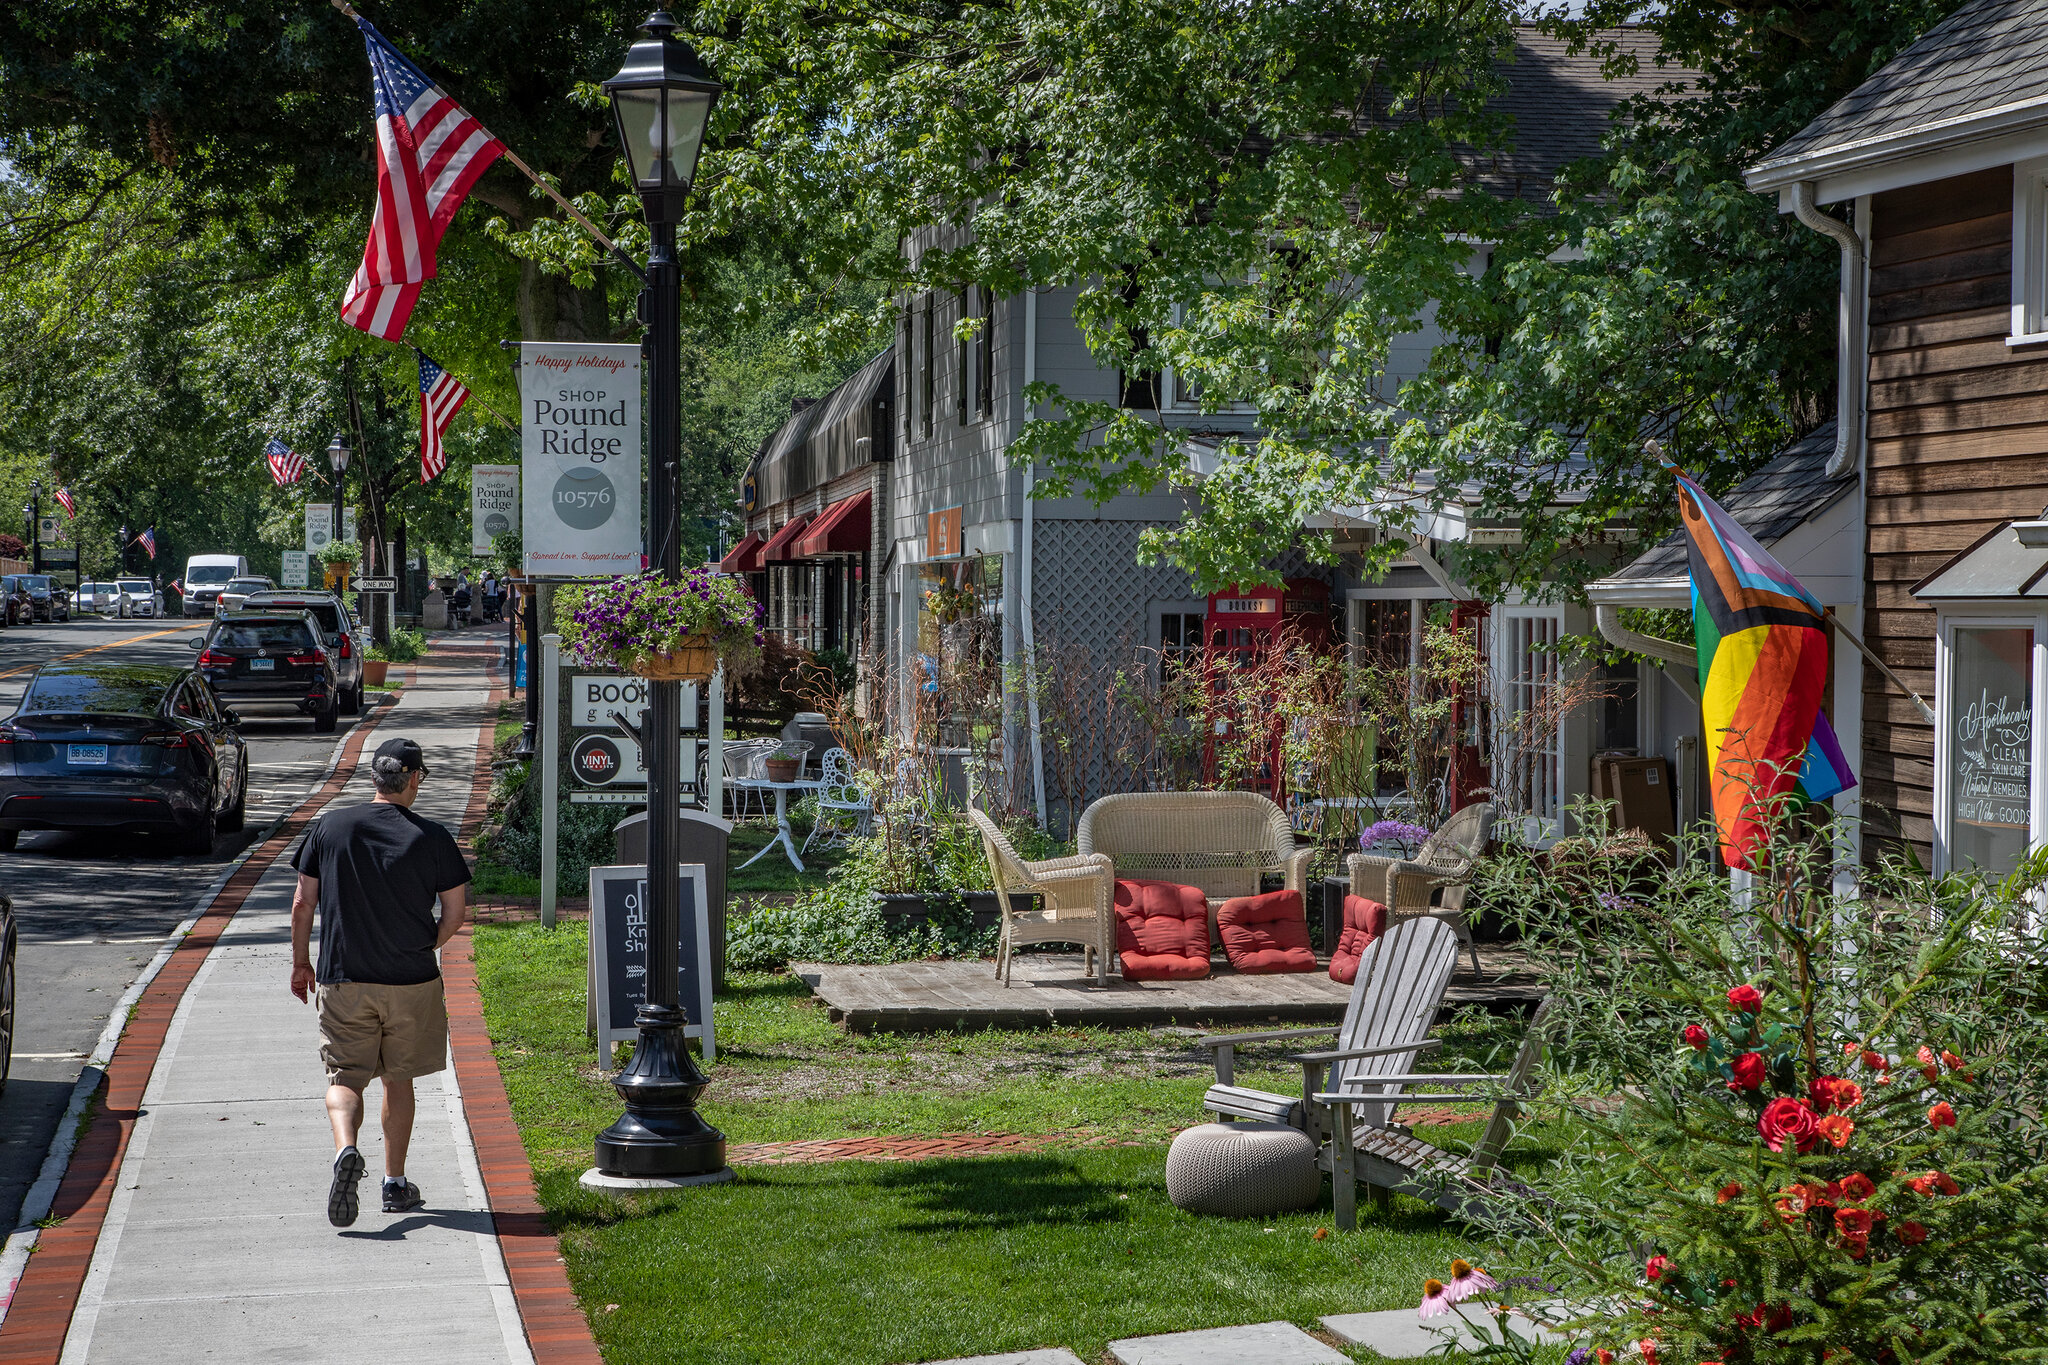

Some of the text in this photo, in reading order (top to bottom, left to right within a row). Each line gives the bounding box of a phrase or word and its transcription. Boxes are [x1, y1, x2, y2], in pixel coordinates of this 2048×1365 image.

[535, 354, 626, 374] Happy Holidays
[559, 390, 606, 402] SHOP
[533, 400, 627, 426] Pound
[541, 428, 622, 463] Ridge
[476, 486, 514, 498] Pound
[556, 486, 610, 508] 10576
[479, 498, 512, 512] Ridge
[485, 521, 507, 530] 10576
[531, 551, 560, 562] Spread
[580, 552, 611, 562] Support
[1229, 601, 1263, 611] BOOKSY
[1958, 688, 2031, 752] Apothecary
[581, 755, 614, 765] VINYL
[1992, 743, 2025, 762] CLEAN
[1992, 763, 2026, 778] SKIN CARE
[1957, 762, 2027, 798] Natural REMEDIES
[1958, 800, 2031, 825] HIGH Vibe GOODS
